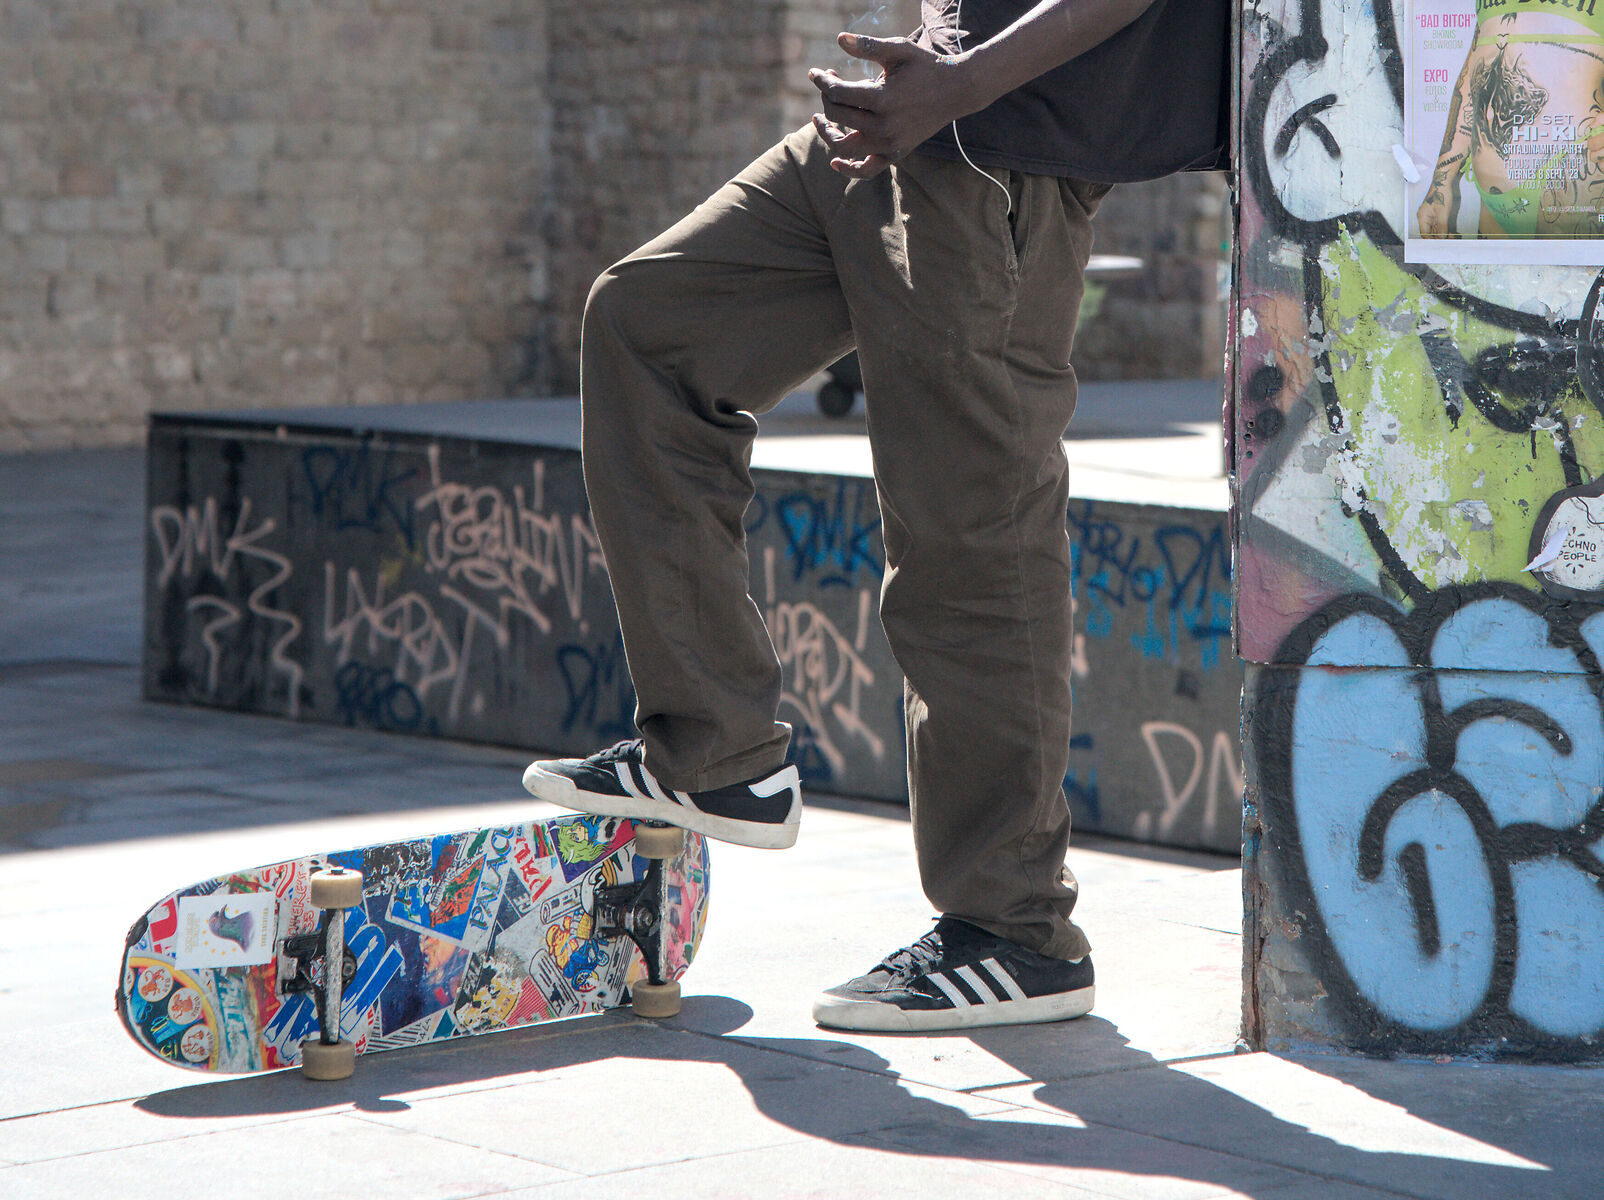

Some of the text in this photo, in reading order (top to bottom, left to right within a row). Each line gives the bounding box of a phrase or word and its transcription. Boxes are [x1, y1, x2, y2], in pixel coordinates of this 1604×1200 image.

[1424, 69, 1449, 83] EXPO
[1513, 114, 1574, 125] DJ SET
[1560, 143, 1585, 154] PARTY
[1561, 157, 1582, 169] SHOP
[1508, 169, 1537, 180] VIERNES
[1538, 169, 1544, 179] 8
[1545, 169, 1565, 180] SEPT.
